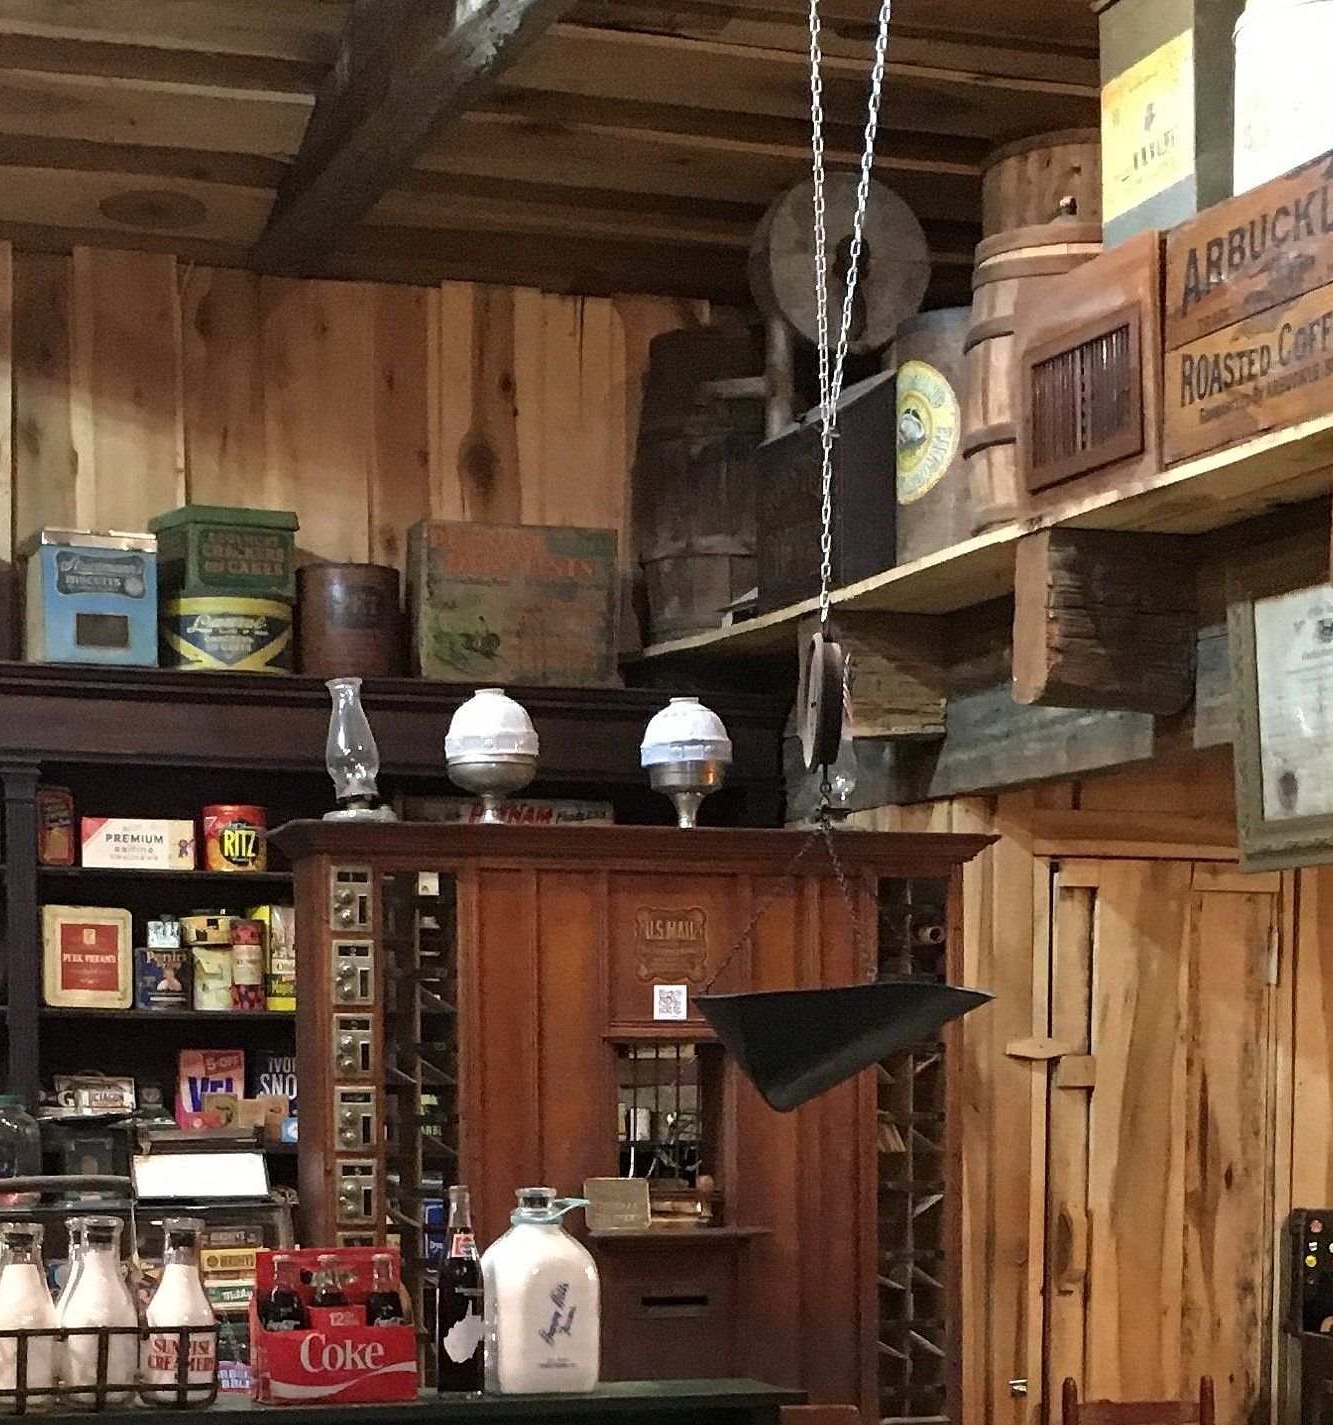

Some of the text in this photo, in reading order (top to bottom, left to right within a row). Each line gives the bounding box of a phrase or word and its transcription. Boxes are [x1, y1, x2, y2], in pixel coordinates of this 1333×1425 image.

[1180, 344, 1271, 408] ROASTED
[105, 833, 164, 844] PREMIUM
[223, 829, 257, 858] RITZ
[259, 1073, 298, 1101] SNO
[300, 1333, 385, 1374] Coke
